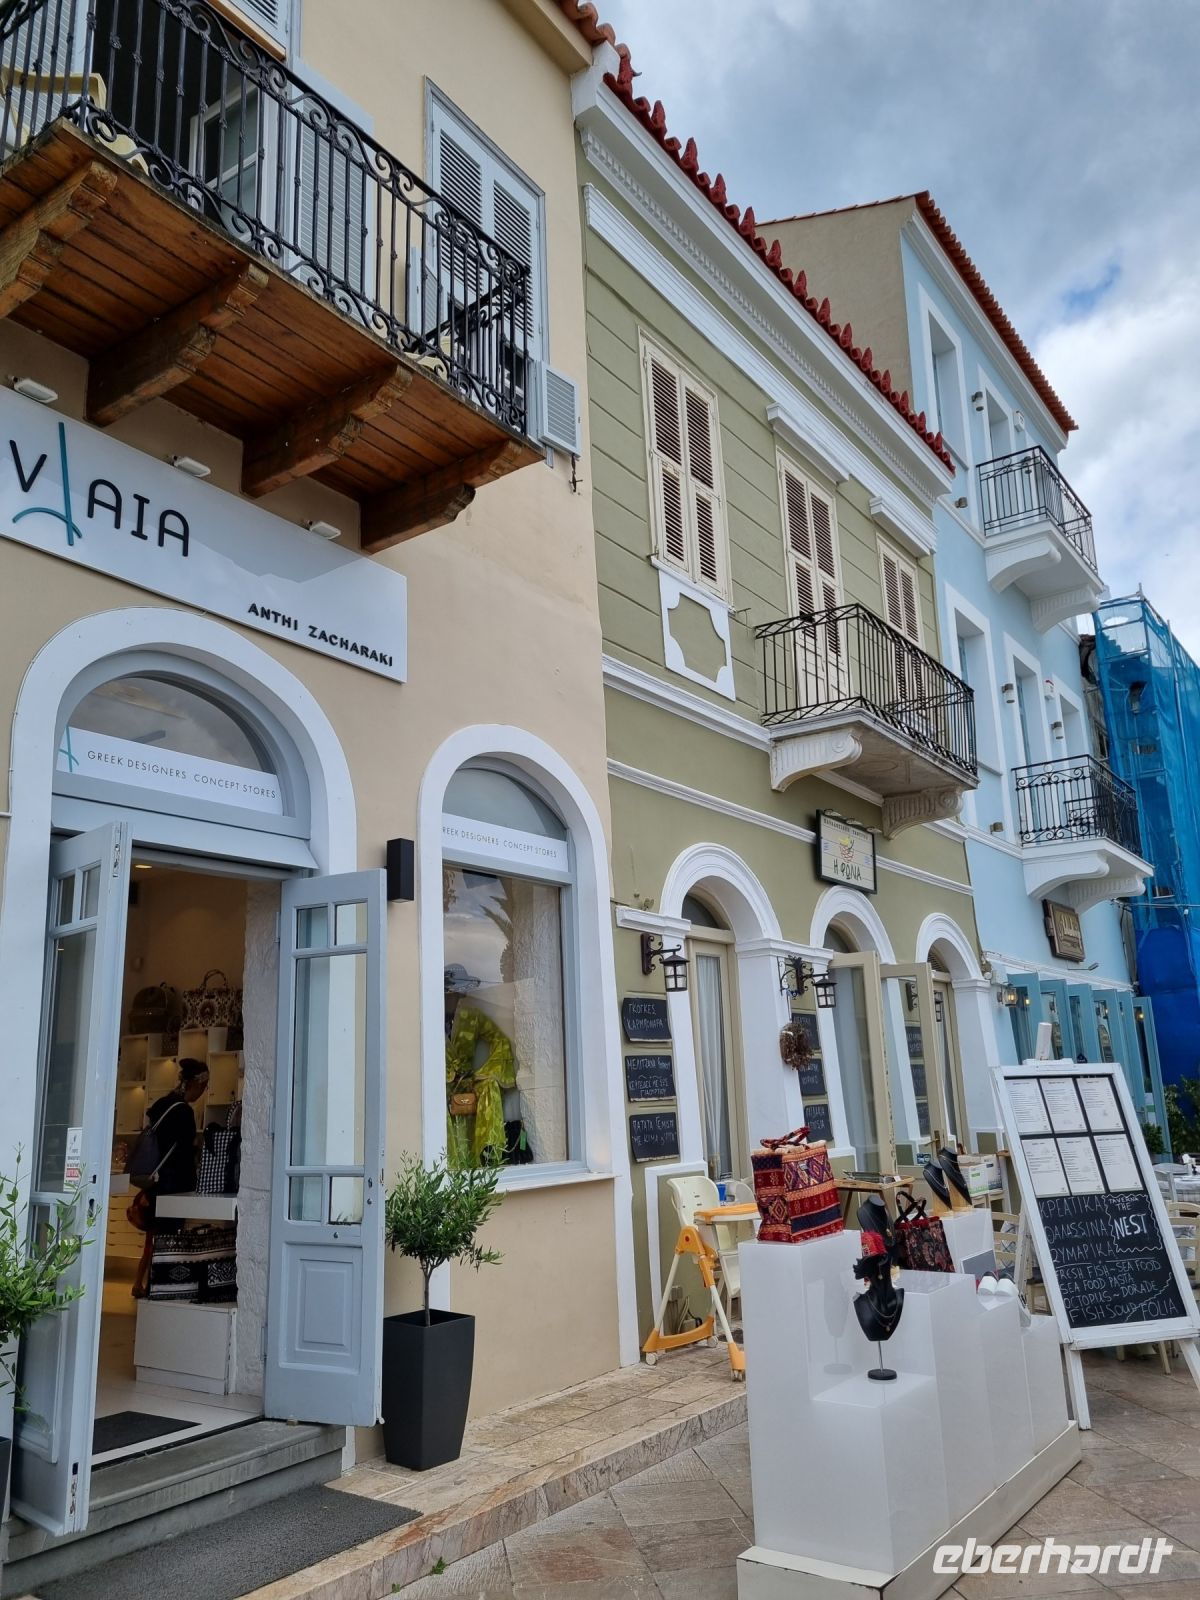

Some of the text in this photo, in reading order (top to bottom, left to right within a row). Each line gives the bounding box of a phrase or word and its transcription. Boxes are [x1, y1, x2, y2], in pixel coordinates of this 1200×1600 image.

[247, 602, 394, 667] ANTHI ZACHARAKI
[87, 750, 276, 799] GREEK DESIGNERS CONCEPT STORES
[442, 826, 557, 859] REEK DESIGNERS CONCEPT STORES
[1116, 1202, 1132, 1211] THE
[1113, 1213, 1148, 1240] NEST
[1055, 1260, 1161, 1280] FRESH FISH SEA FOOD
[1060, 1273, 1134, 1294] SEA FOOD PASTA
[1063, 1280, 1158, 1309] OCTOPUS DORADE
[1068, 1303, 1106, 1322] FISH
[1140, 1298, 1179, 1321] FOLIA
